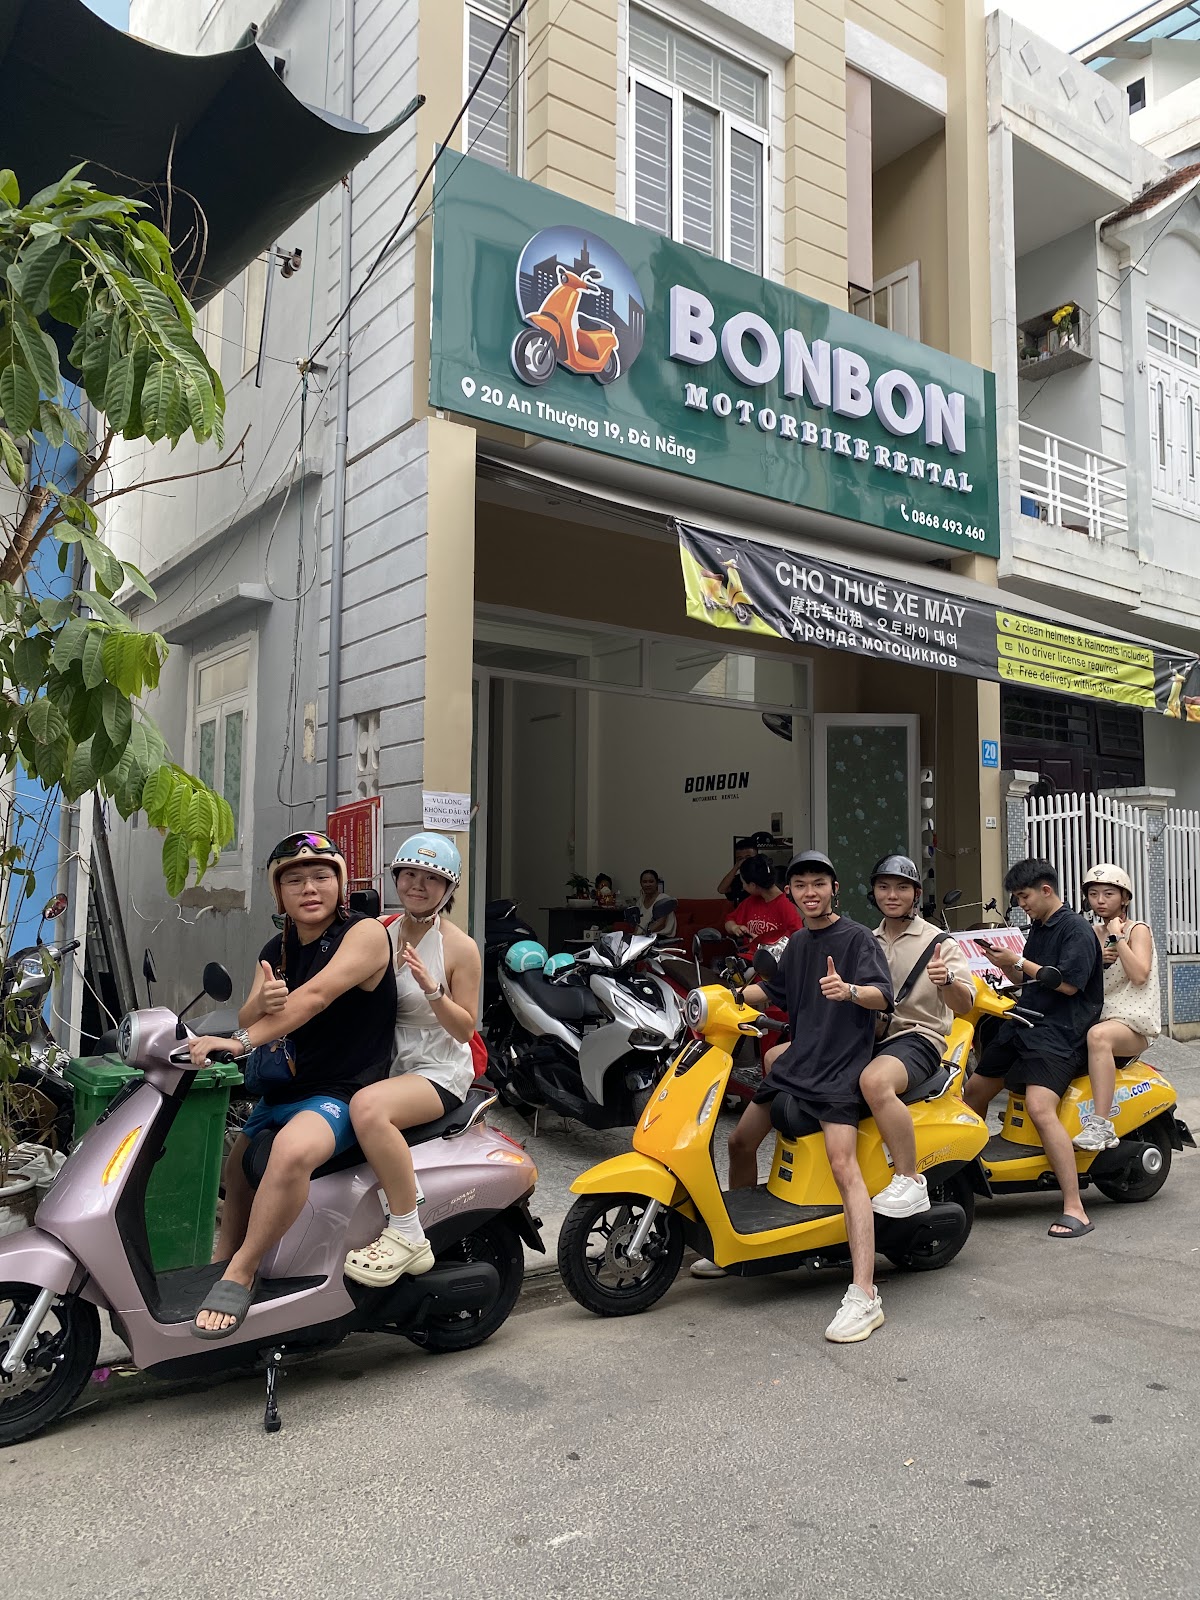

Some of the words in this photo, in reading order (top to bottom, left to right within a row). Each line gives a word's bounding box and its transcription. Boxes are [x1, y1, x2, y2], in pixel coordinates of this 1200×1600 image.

[670, 284, 966, 455] BONBON
[480, 385, 503, 406] 20
[506, 394, 532, 414] An
[536, 402, 599, 438] Thượng
[604, 420, 624, 444] 19,
[627, 427, 651, 448] Đà
[655, 435, 696, 464] Nẵng
[684, 382, 870, 461] MOTORBIKE
[874, 445, 973, 493] RENTAL
[912, 509, 940, 529] 0868
[942, 518, 963, 535] 493
[965, 525, 986, 542] 460
[775, 561, 824, 594] CHO
[830, 574, 888, 610] THUÊ
[893, 590, 919, 618] XE
[924, 598, 966, 628] MÁY
[789, 596, 864, 629] 摩托车出租
[877, 617, 930, 644] 오토바이
[934, 629, 958, 650] 대여
[791, 618, 857, 648] Аренда
[862, 636, 958, 668] мотоциклов
[1015, 621, 1021, 631] 2
[1022, 623, 1044, 637] clean
[1045, 627, 1075, 645] helmets
[1077, 636, 1083, 647] &
[1084, 638, 1120, 656] Raincoats
[1018, 642, 1030, 655] No
[1032, 645, 1056, 661] driver
[1057, 651, 1086, 668] license
[1087, 657, 1119, 675] required
[1019, 665, 1038, 680] Free
[1040, 668, 1072, 688] delivery
[1073, 677, 1098, 691] within
[1098, 683, 1114, 695] 3km
[984, 743, 996, 760] 20
[684, 771, 750, 794] BONBON
